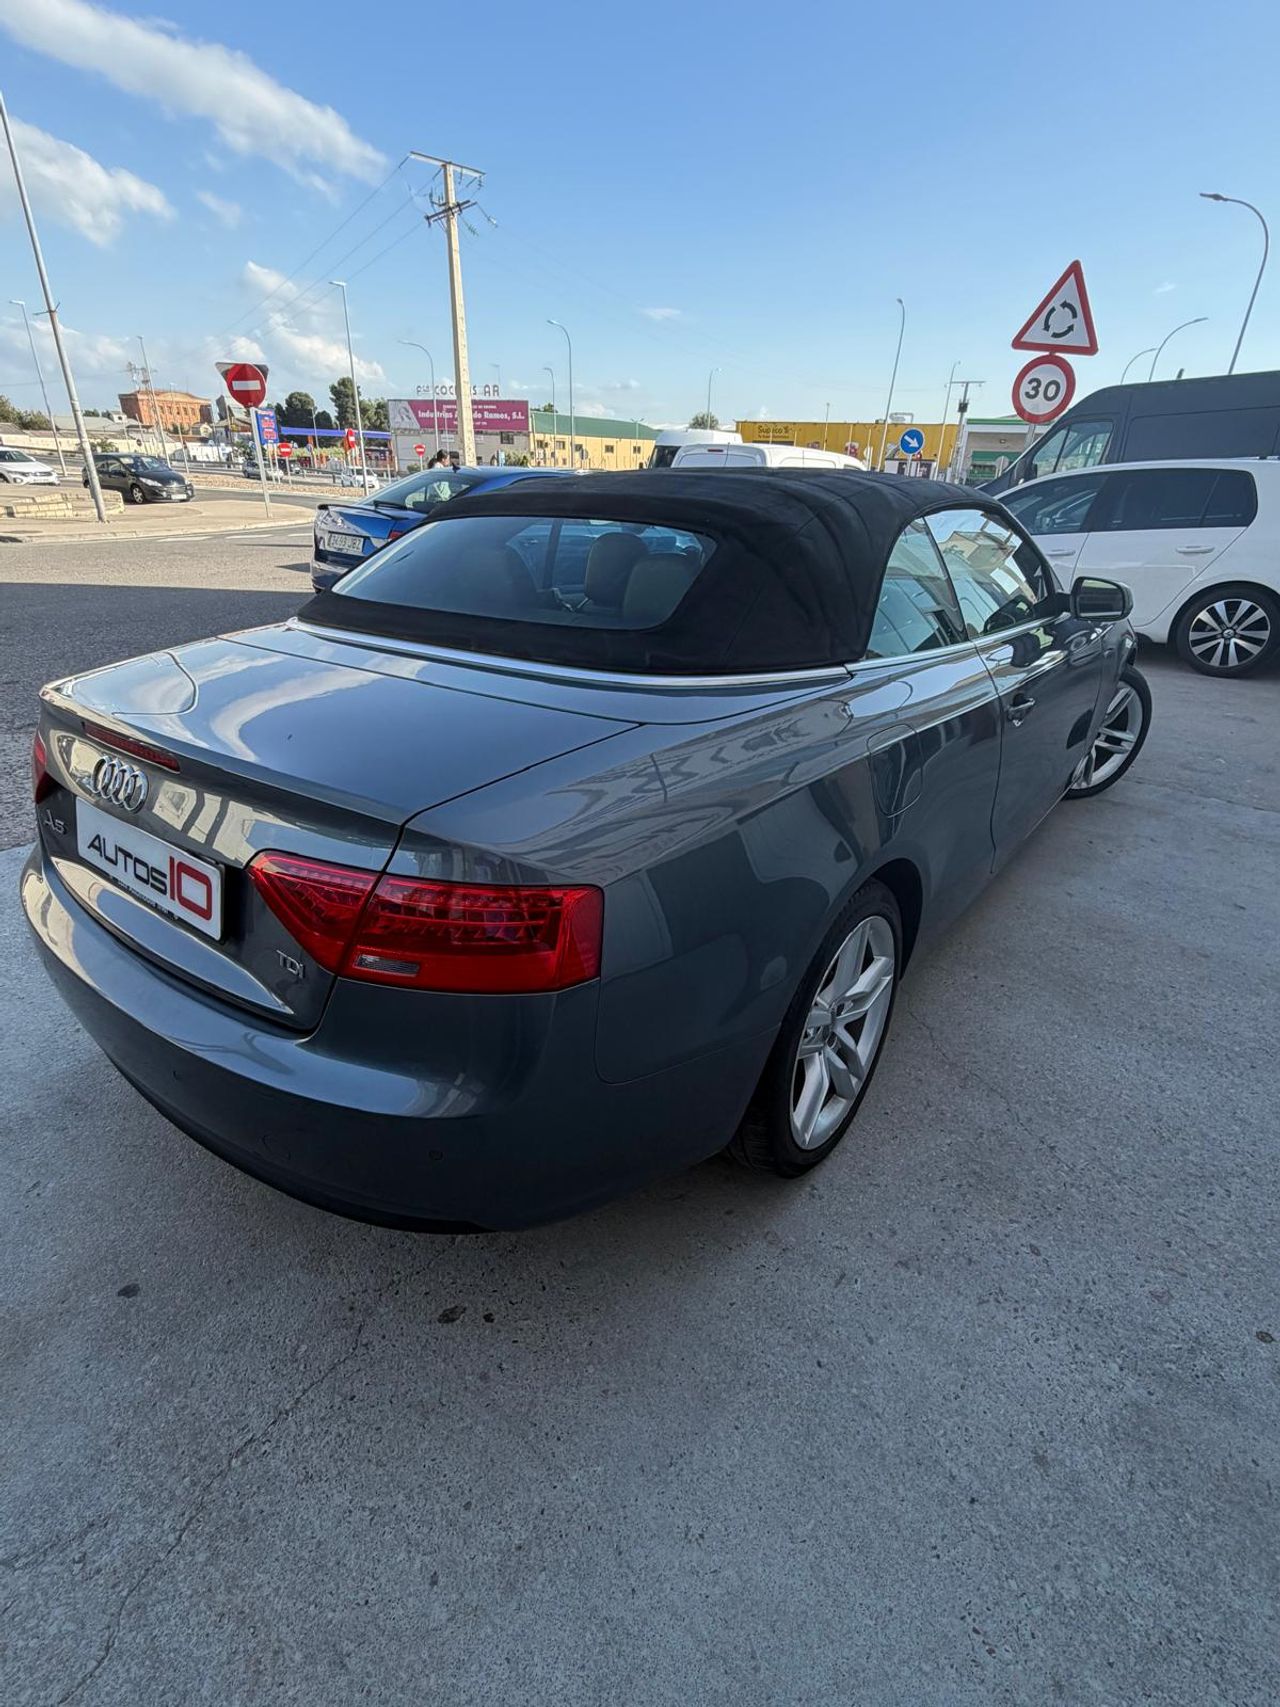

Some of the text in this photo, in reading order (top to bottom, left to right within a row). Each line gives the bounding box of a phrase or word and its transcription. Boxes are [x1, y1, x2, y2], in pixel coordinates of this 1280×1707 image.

[1024, 377, 1061, 402] 30
[418, 411, 454, 419] Indutrias
[44, 809, 66, 834] A5
